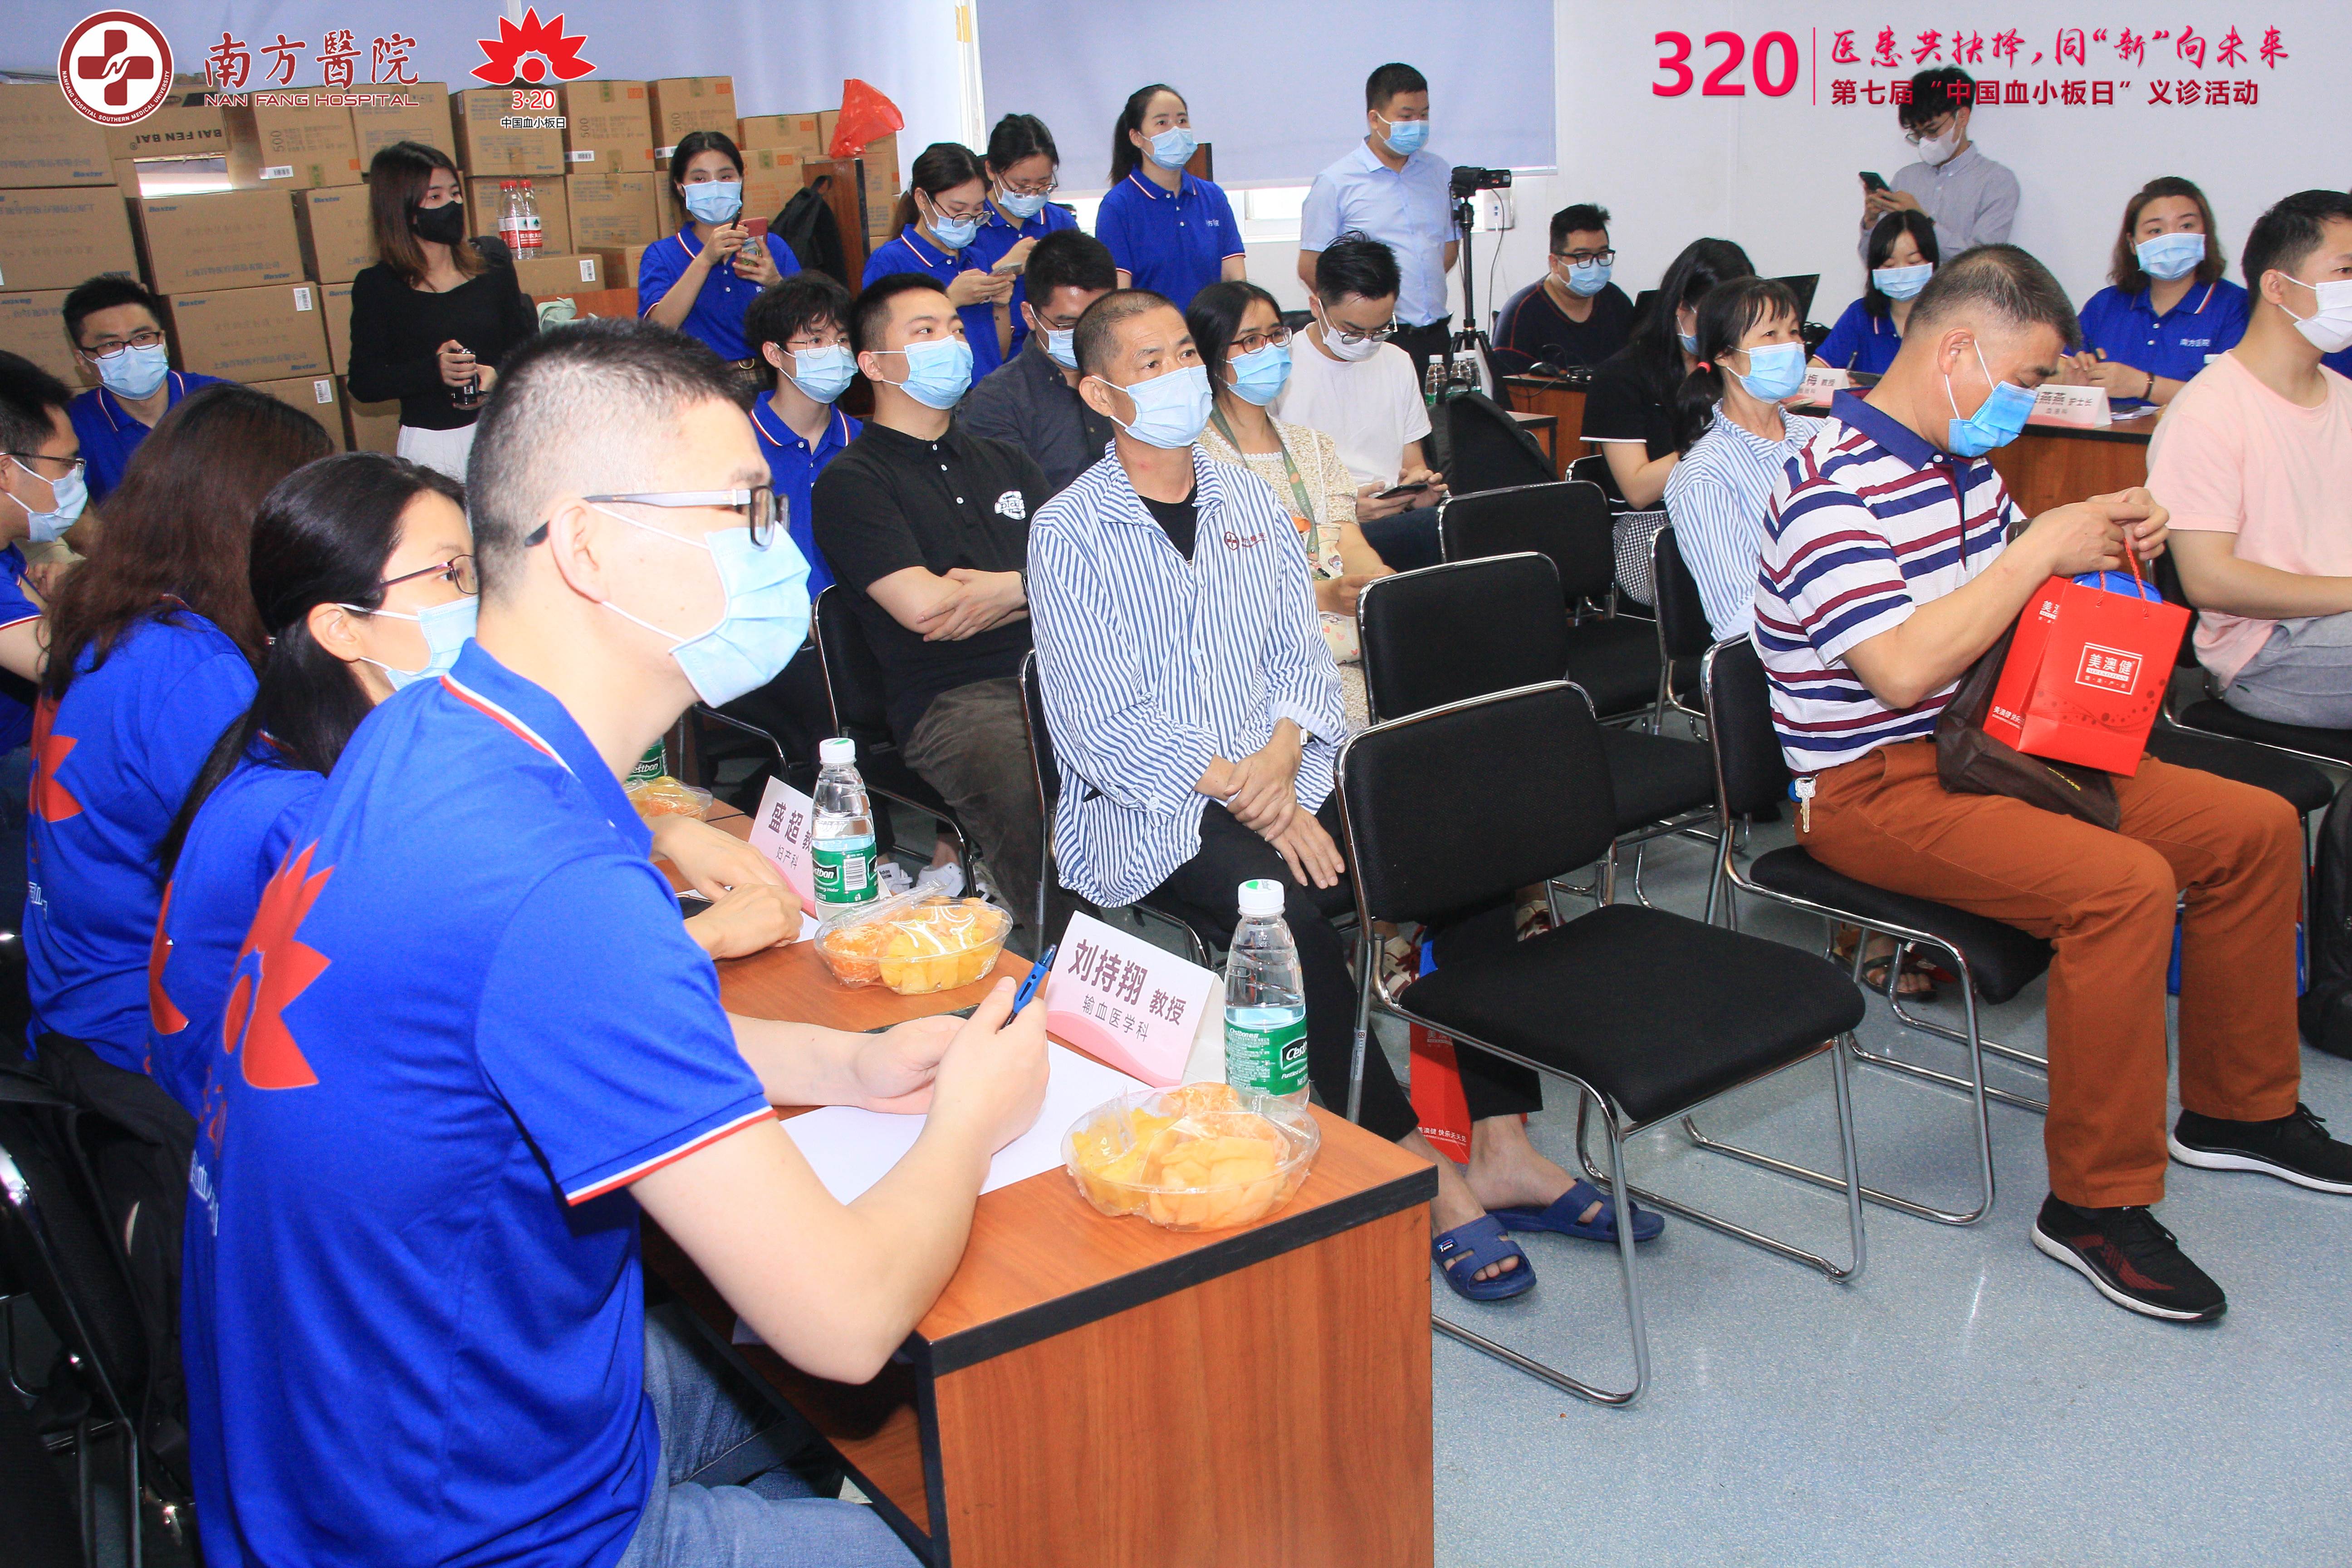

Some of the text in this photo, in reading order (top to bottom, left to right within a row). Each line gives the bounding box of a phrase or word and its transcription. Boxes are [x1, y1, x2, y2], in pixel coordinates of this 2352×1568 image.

[2034, 392, 2067, 406] 燕燕
[2087, 654, 2132, 675] 美澳健
[632, 763, 658, 773] estbon
[802, 829, 813, 854] 教
[776, 844, 799, 870] 妇产科
[1068, 939, 1186, 1026] 刘持翔 教授
[1083, 994, 1149, 1042] 输血医学科
[1438, 1129, 1466, 1143] 快乐天天见
